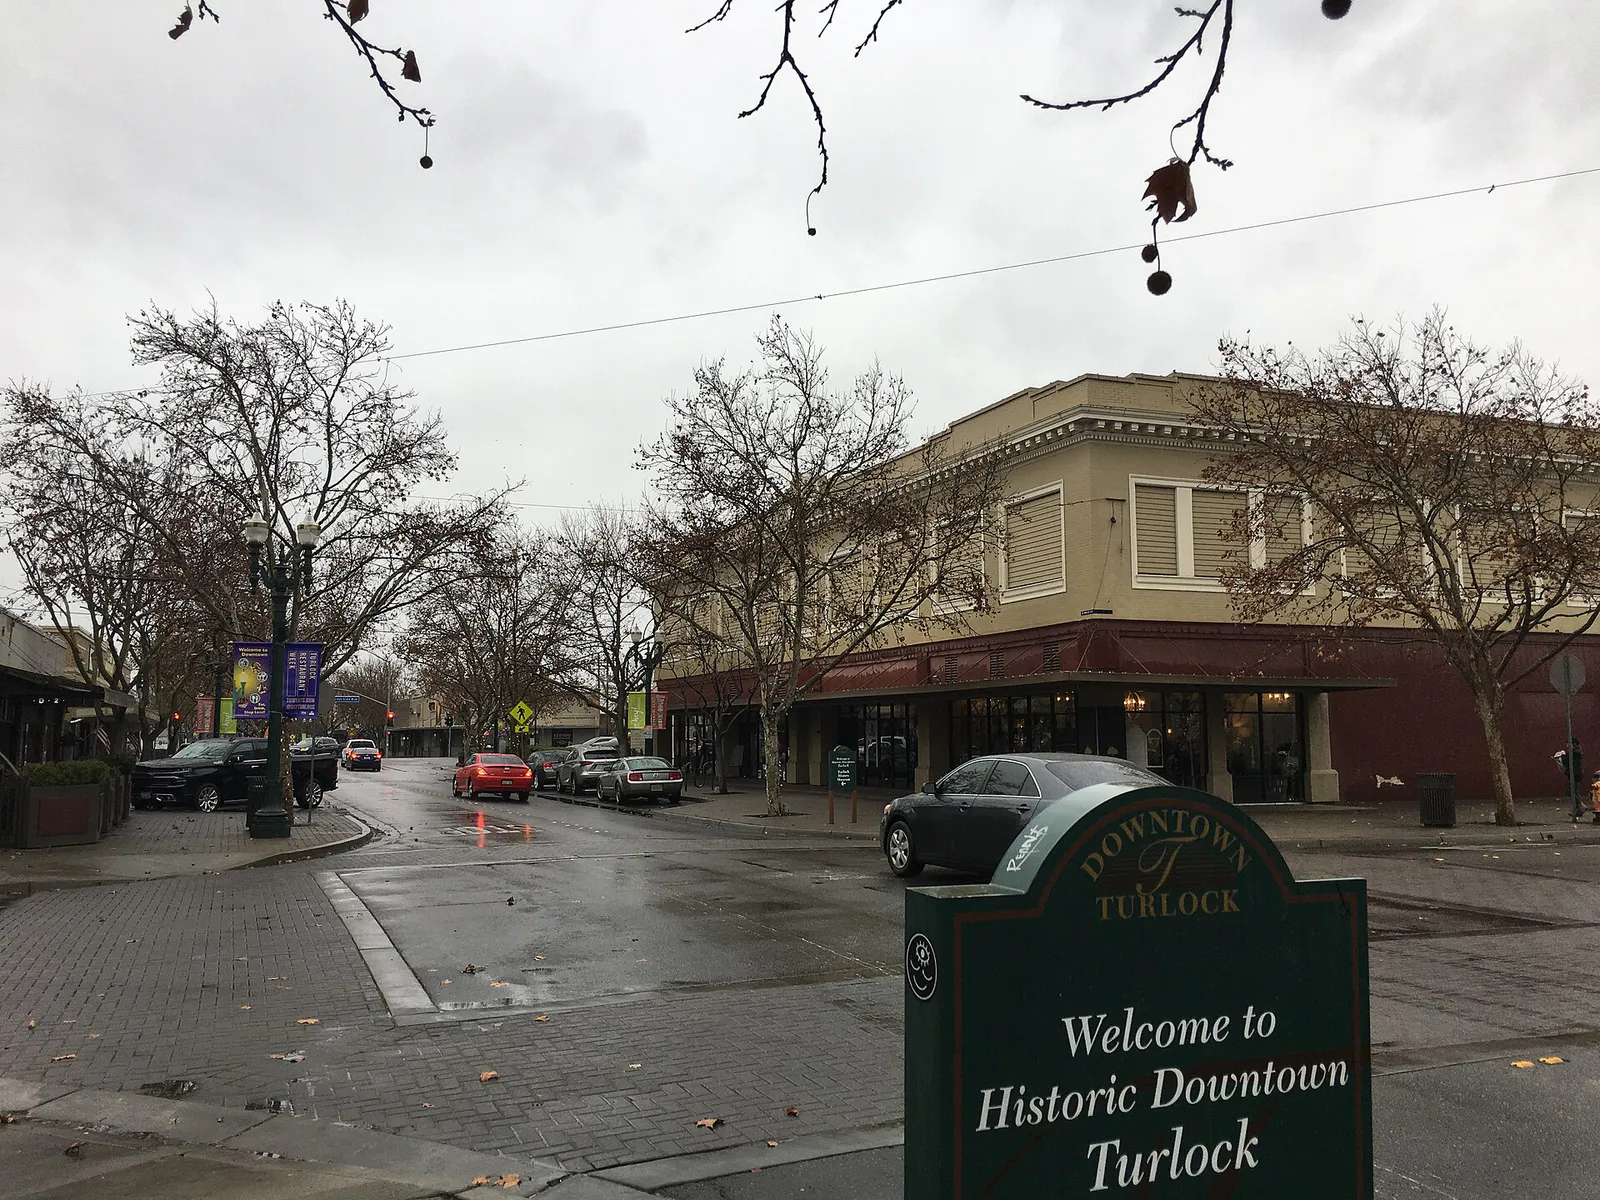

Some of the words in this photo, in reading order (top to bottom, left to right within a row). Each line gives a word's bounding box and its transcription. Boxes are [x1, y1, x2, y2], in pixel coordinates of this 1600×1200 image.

[288, 652, 297, 670] WEEK
[298, 652, 307, 692] RESTAURANT
[309, 652, 318, 680] TURLOCK
[1080, 809, 1253, 883] DOWNTOWN
[1096, 889, 1240, 921] TURLOCK
[1061, 1006, 1229, 1058] Welcome
[1242, 1005, 1276, 1040] to
[975, 1073, 1137, 1132] Historic
[1150, 1059, 1349, 1110] Downtown
[1086, 1117, 1259, 1193] Turlock
